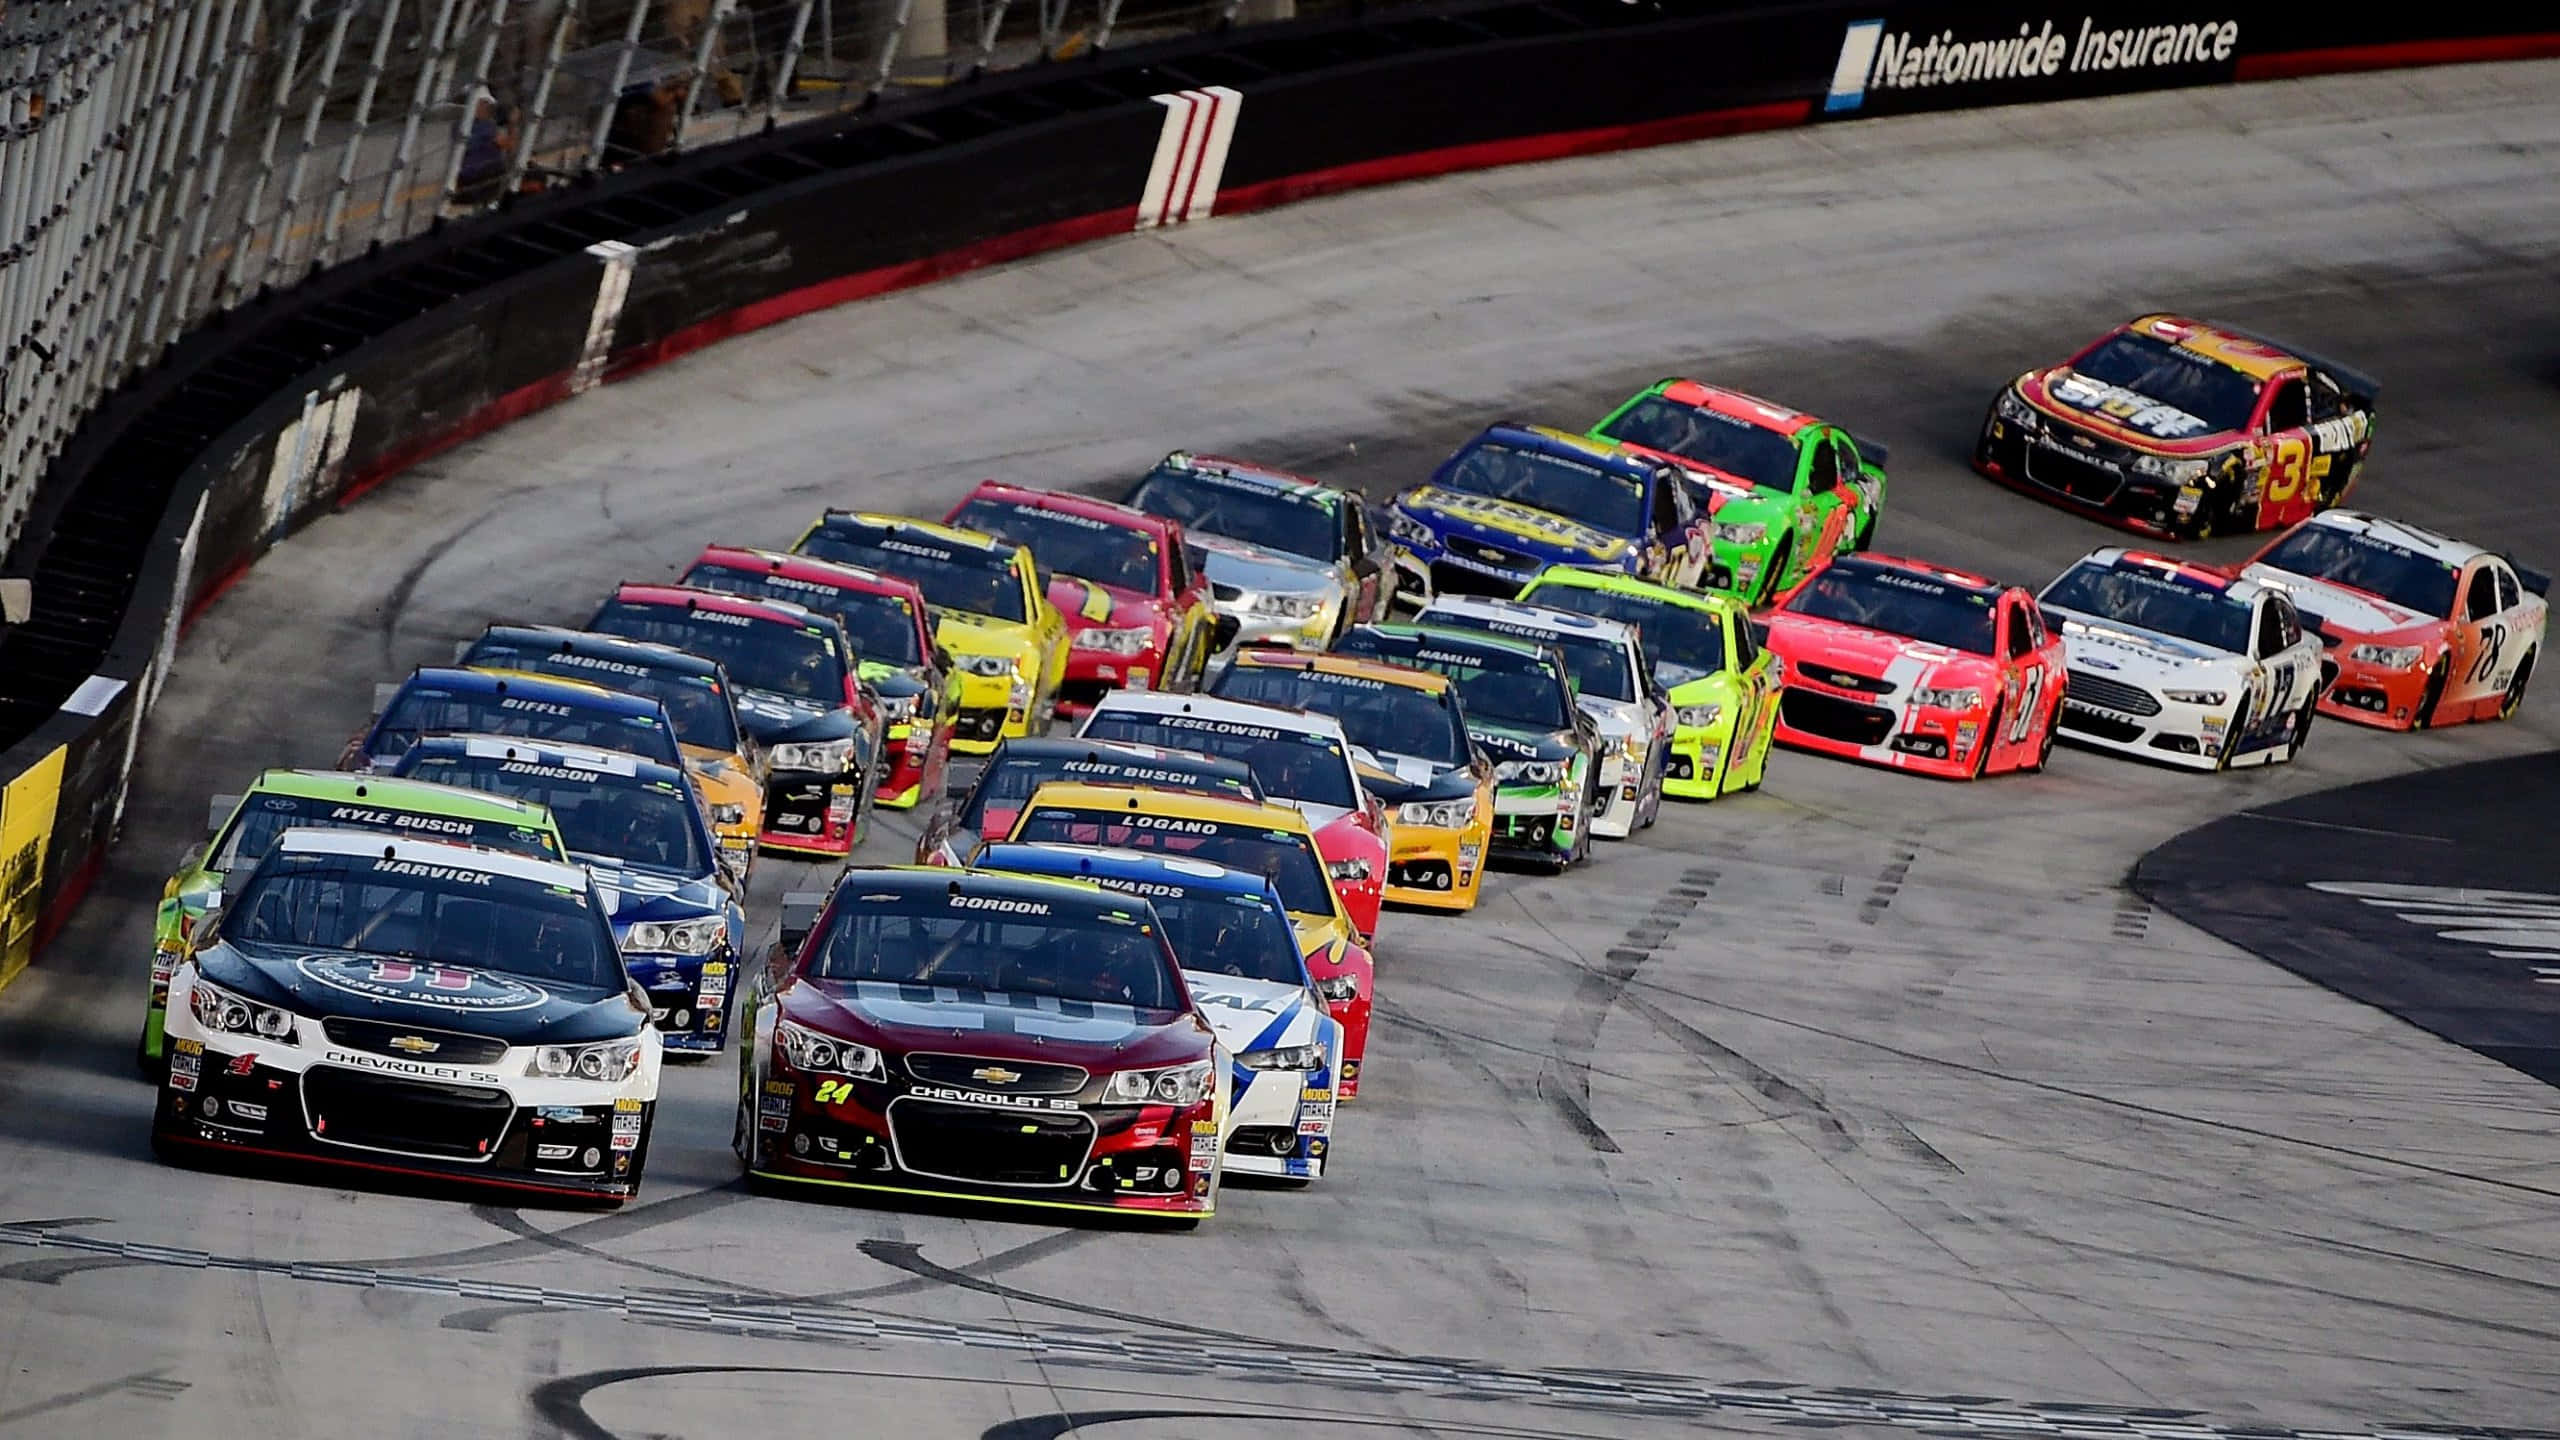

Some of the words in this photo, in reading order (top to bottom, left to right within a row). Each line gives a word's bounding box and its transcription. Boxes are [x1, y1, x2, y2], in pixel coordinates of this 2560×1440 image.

[1871, 19, 2066, 89] Nationwide
[2070, 16, 2239, 73] Insurance
[2268, 439, 2306, 503] 3
[879, 539, 951, 561] KENSETH
[765, 575, 840, 597] BOWYER
[1875, 574, 1945, 595] ALLGAIER
[689, 610, 751, 628] KAHNE
[1487, 620, 1560, 641] VICKERS
[547, 652, 650, 678] AMBROSE
[1416, 648, 1482, 668] HAMLIN
[2464, 624, 2507, 686] 78
[1297, 671, 1385, 691] NEWMAN
[501, 698, 572, 717] BIFFLE
[1158, 716, 1280, 740] KESELOWSKI
[500, 761, 600, 784] JOHNSON
[1063, 759, 1120, 778] KURT
[1123, 766, 1198, 785] BUSCH
[331, 807, 391, 825] KYLE
[394, 815, 475, 835] BUSCH
[1122, 815, 1218, 835] LOGANO
[373, 859, 495, 886] HARVICK
[229, 1053, 259, 1076] 4
[325, 1051, 463, 1081] CHEVROLET
[469, 1071, 499, 1083] SS
[815, 1080, 854, 1104] 24
[910, 1086, 1043, 1108] CHEVROLET
[1050, 1099, 1079, 1110] SS
[1301, 1088, 1331, 1101] MOOG
